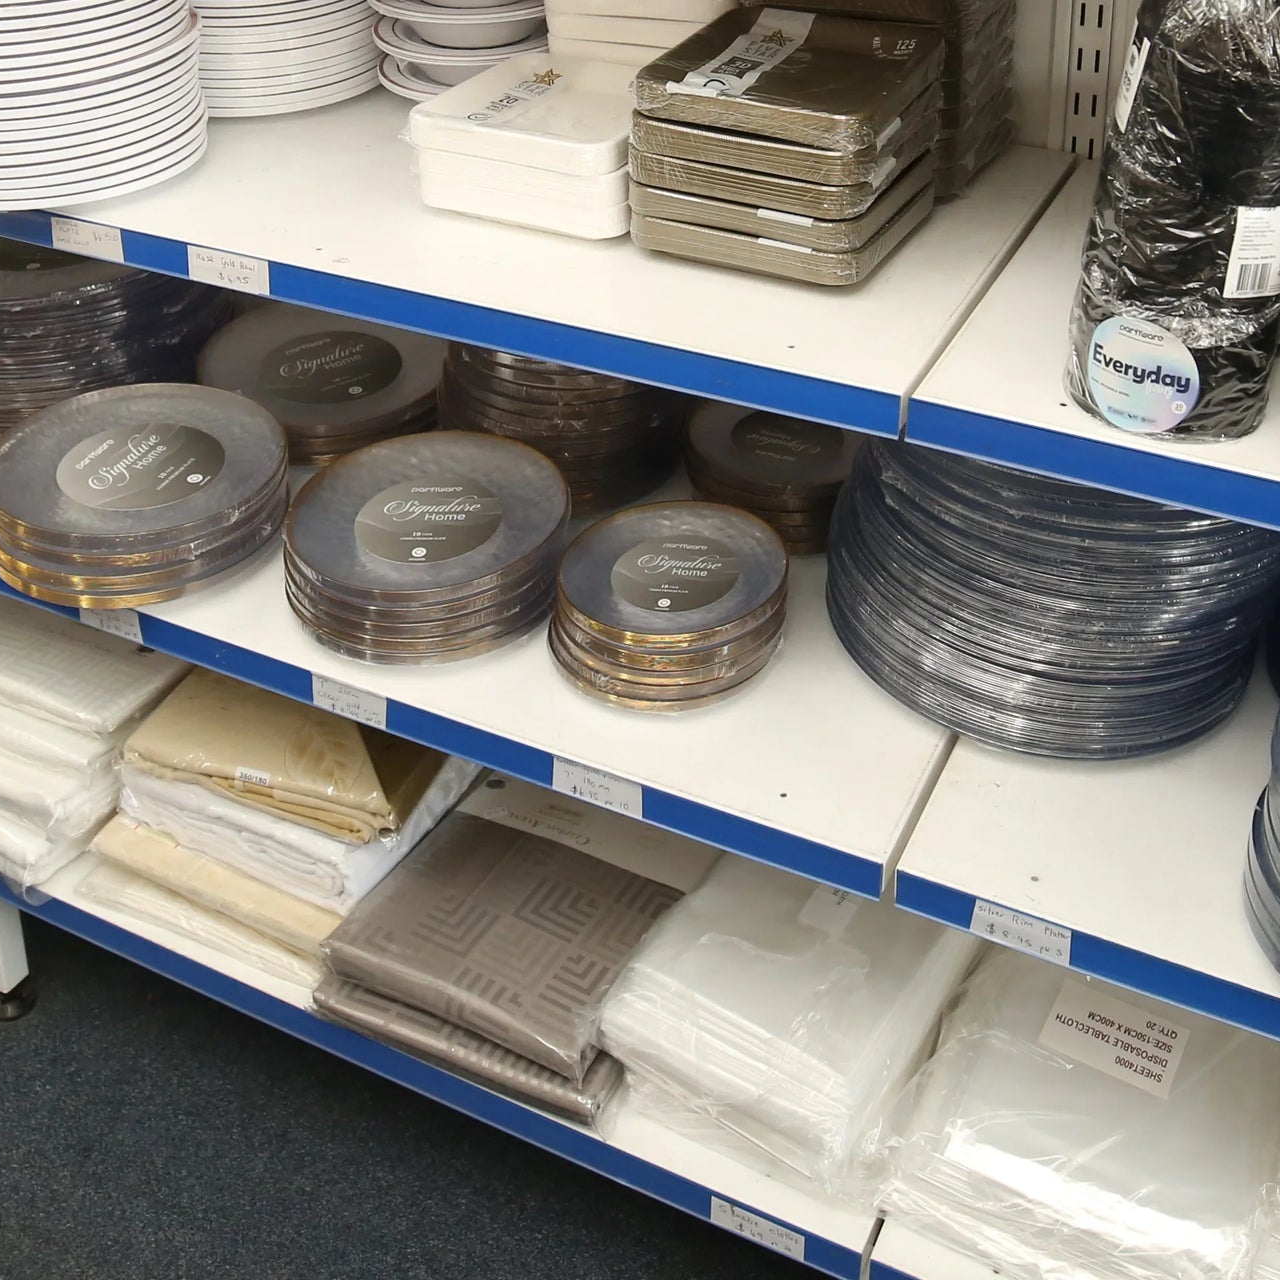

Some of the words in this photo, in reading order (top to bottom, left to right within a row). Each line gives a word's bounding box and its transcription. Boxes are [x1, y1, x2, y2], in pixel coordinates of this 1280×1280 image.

[896, 40, 917, 50] 125
[498, 96, 519, 105] 20
[280, 343, 364, 379] Signature
[324, 353, 363, 371] Home
[1092, 342, 1191, 394] Everyday
[88, 434, 161, 490] Signature
[134, 444, 166, 470] Home
[383, 495, 481, 521] Signature
[425, 512, 466, 521] Home
[637, 554, 722, 574] Signature
[671, 568, 708, 577] Home
[1012, 914, 1034, 927] Rim
[1088, 1010, 1116, 1031] 400CM
[1116, 1024, 1123, 1033] X
[1145, 1020, 1159, 1030] 20
[1055, 1013, 1109, 1044] TABLECLOTH
[1110, 1034, 1169, 1068] DISPOSABLE
[1114, 1054, 1164, 1083] SHEET4000
